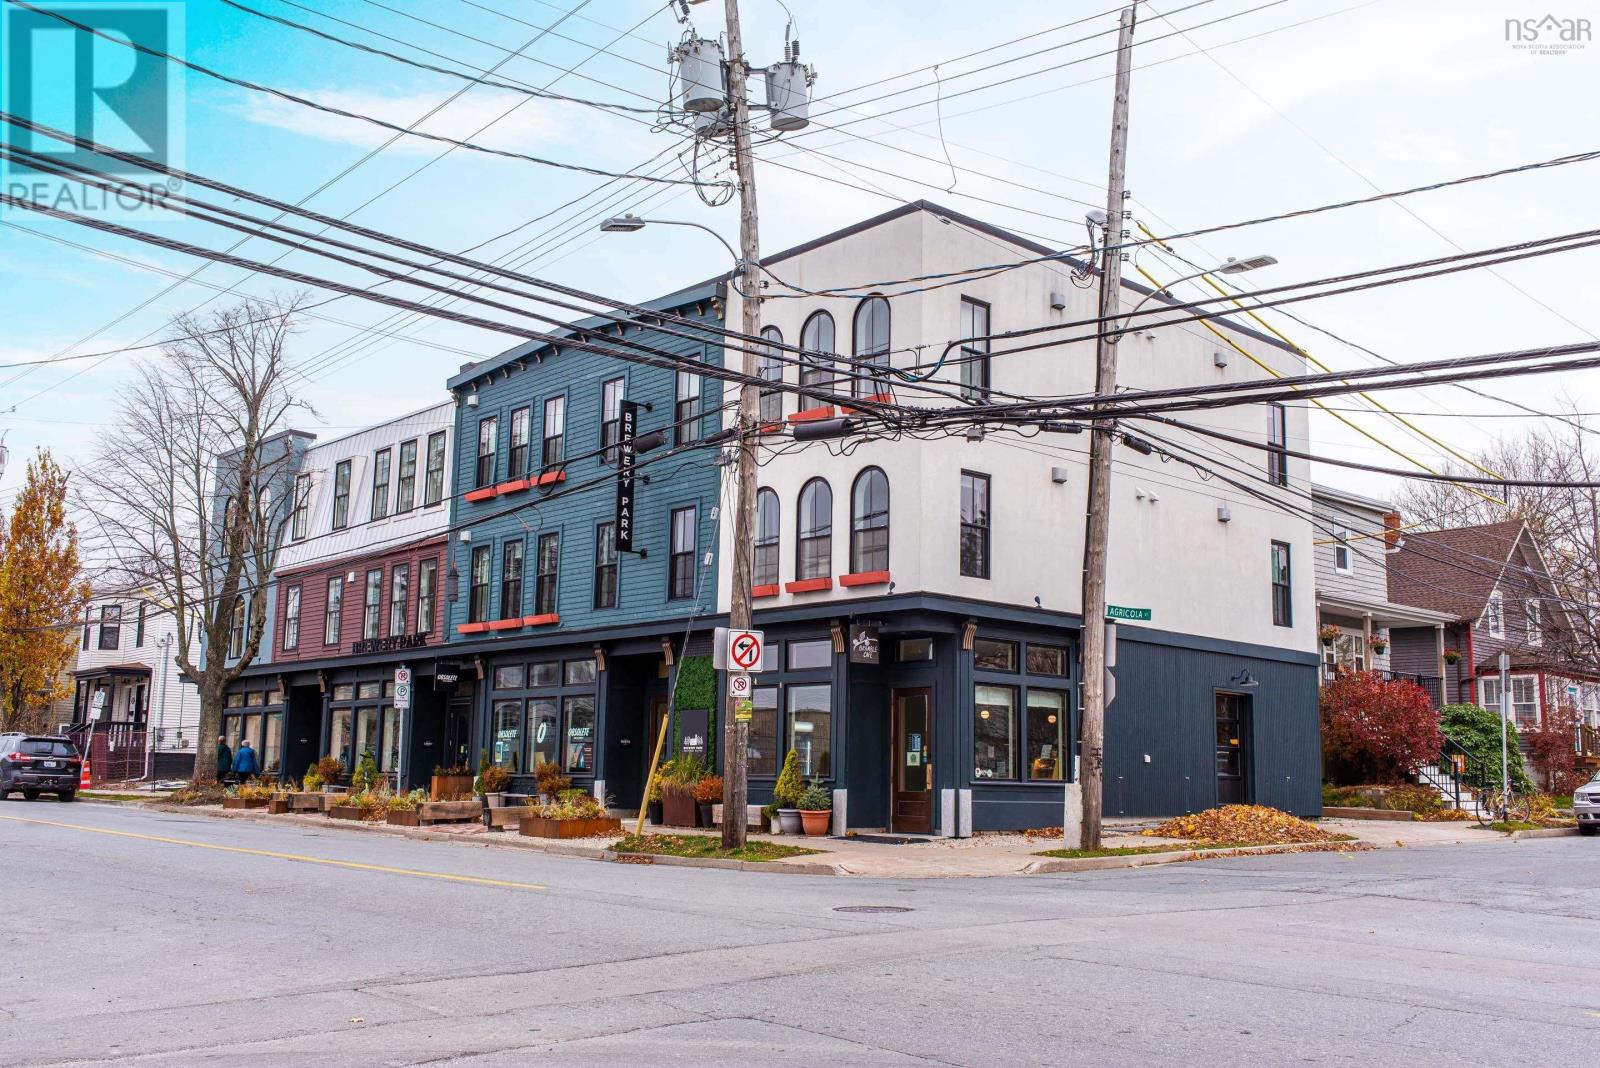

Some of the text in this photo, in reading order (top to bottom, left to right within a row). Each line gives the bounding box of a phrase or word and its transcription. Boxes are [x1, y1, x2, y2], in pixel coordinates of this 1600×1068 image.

[620, 496, 630, 540] PARK
[1110, 607, 1143, 618] AGRICOLA
[498, 729, 518, 739] OBSOLETE
[567, 727, 590, 737] OBSOLETE
